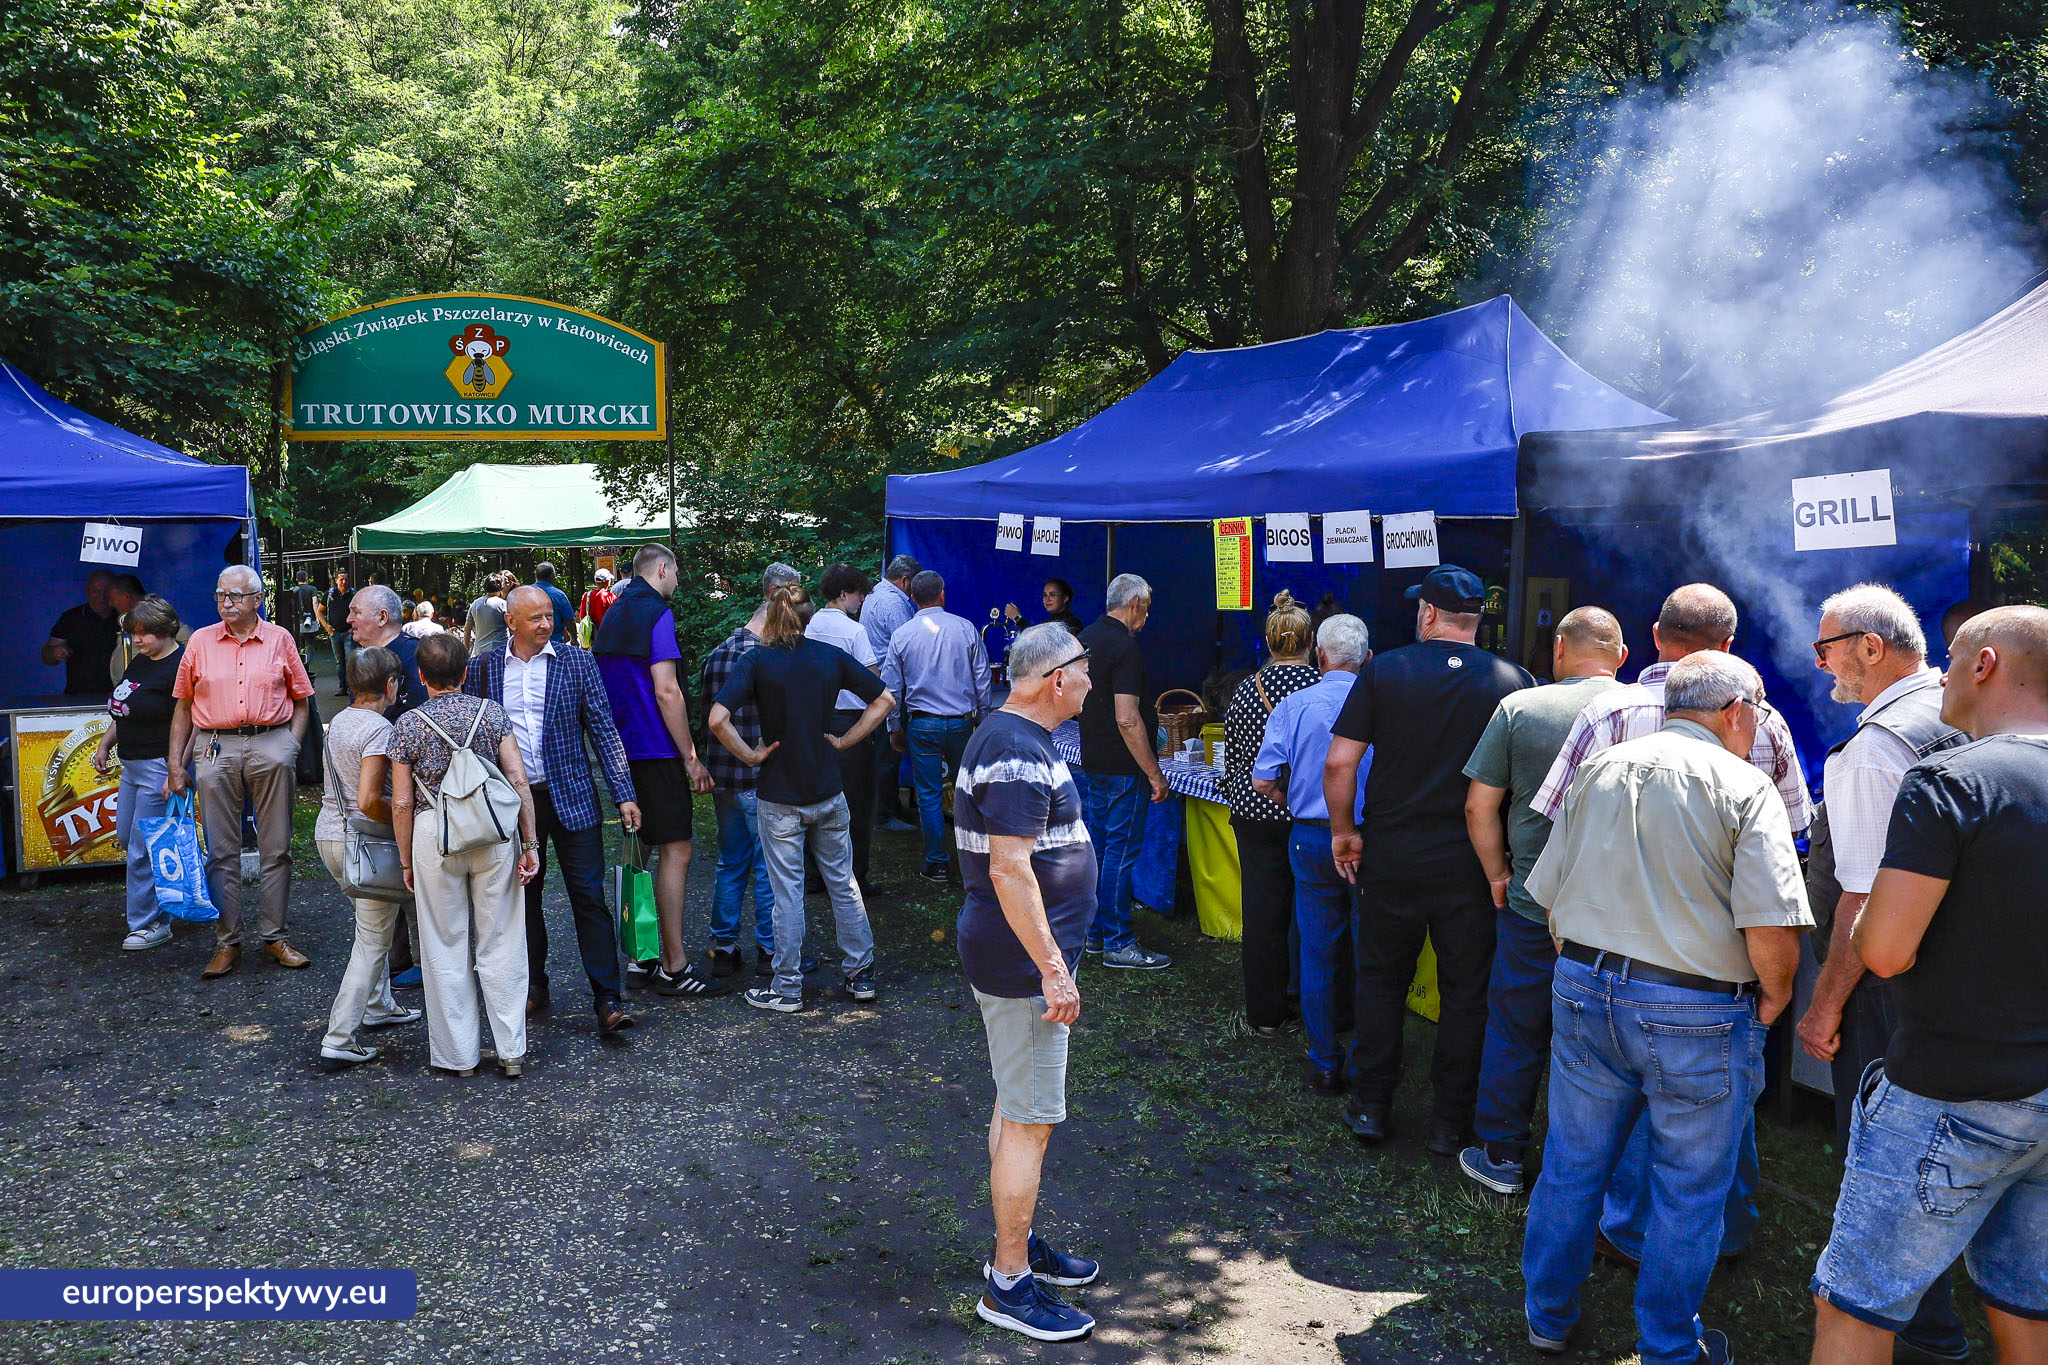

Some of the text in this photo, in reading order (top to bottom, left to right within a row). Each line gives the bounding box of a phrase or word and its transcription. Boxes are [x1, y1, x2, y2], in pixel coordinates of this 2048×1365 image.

[354, 309, 429, 337] Związek
[432, 307, 533, 328] Pszczelarzy
[538, 315, 552, 327] w
[557, 317, 650, 365] Katowicach
[475, 328, 484, 338] Z
[496, 340, 505, 351] P
[300, 403, 650, 425] TRUTOWISKO MURCKI
[1795, 495, 1891, 528] GRILL
[997, 525, 1023, 540] PIWO
[1033, 529, 1060, 543] NAPOJE
[1220, 521, 1246, 534] CENNIK
[1266, 528, 1310, 547] BIGOS
[1335, 526, 1357, 535] PLACKI
[82, 535, 140, 553] PIWO
[1326, 535, 1369, 545] ZIEMNIACZANE
[1385, 526, 1435, 550] GROCHÓWKA
[46, 721, 112, 789] TYSKIE BROWAR
[55, 793, 119, 846] TYS
